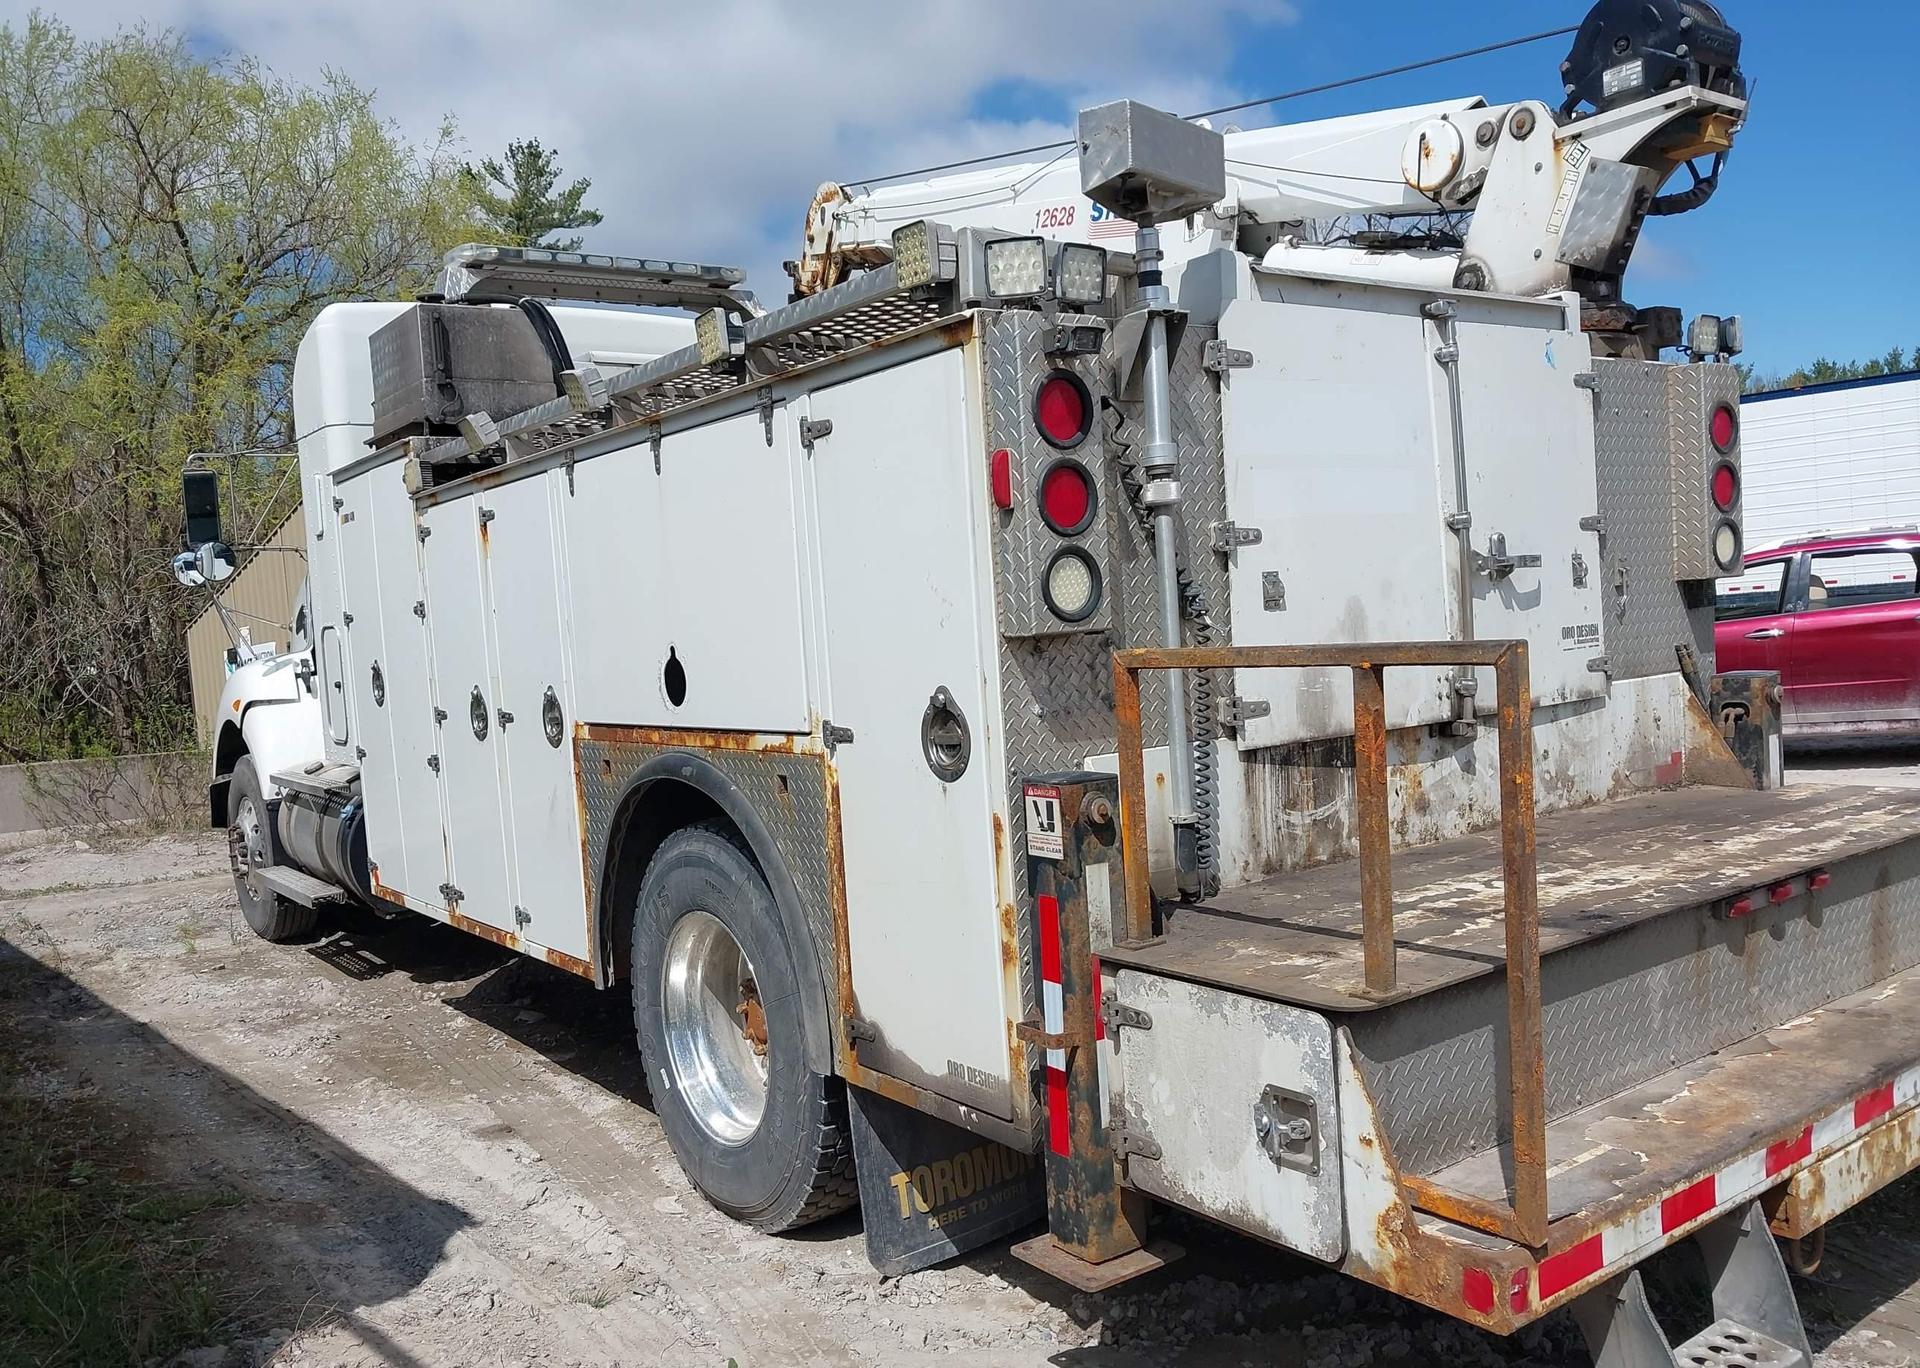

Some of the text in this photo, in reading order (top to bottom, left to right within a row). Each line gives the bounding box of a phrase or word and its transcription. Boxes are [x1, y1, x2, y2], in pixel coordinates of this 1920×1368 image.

[1035, 205, 1075, 229] 12628
[1562, 623, 1599, 640] ORO DESIGN
[1034, 788, 1057, 797] DANGER
[1029, 845, 1063, 855] STAND CLEAR
[966, 1065, 1000, 1091] DESIGN
[928, 1206, 968, 1231] HERE
[970, 1197, 989, 1214] TO
